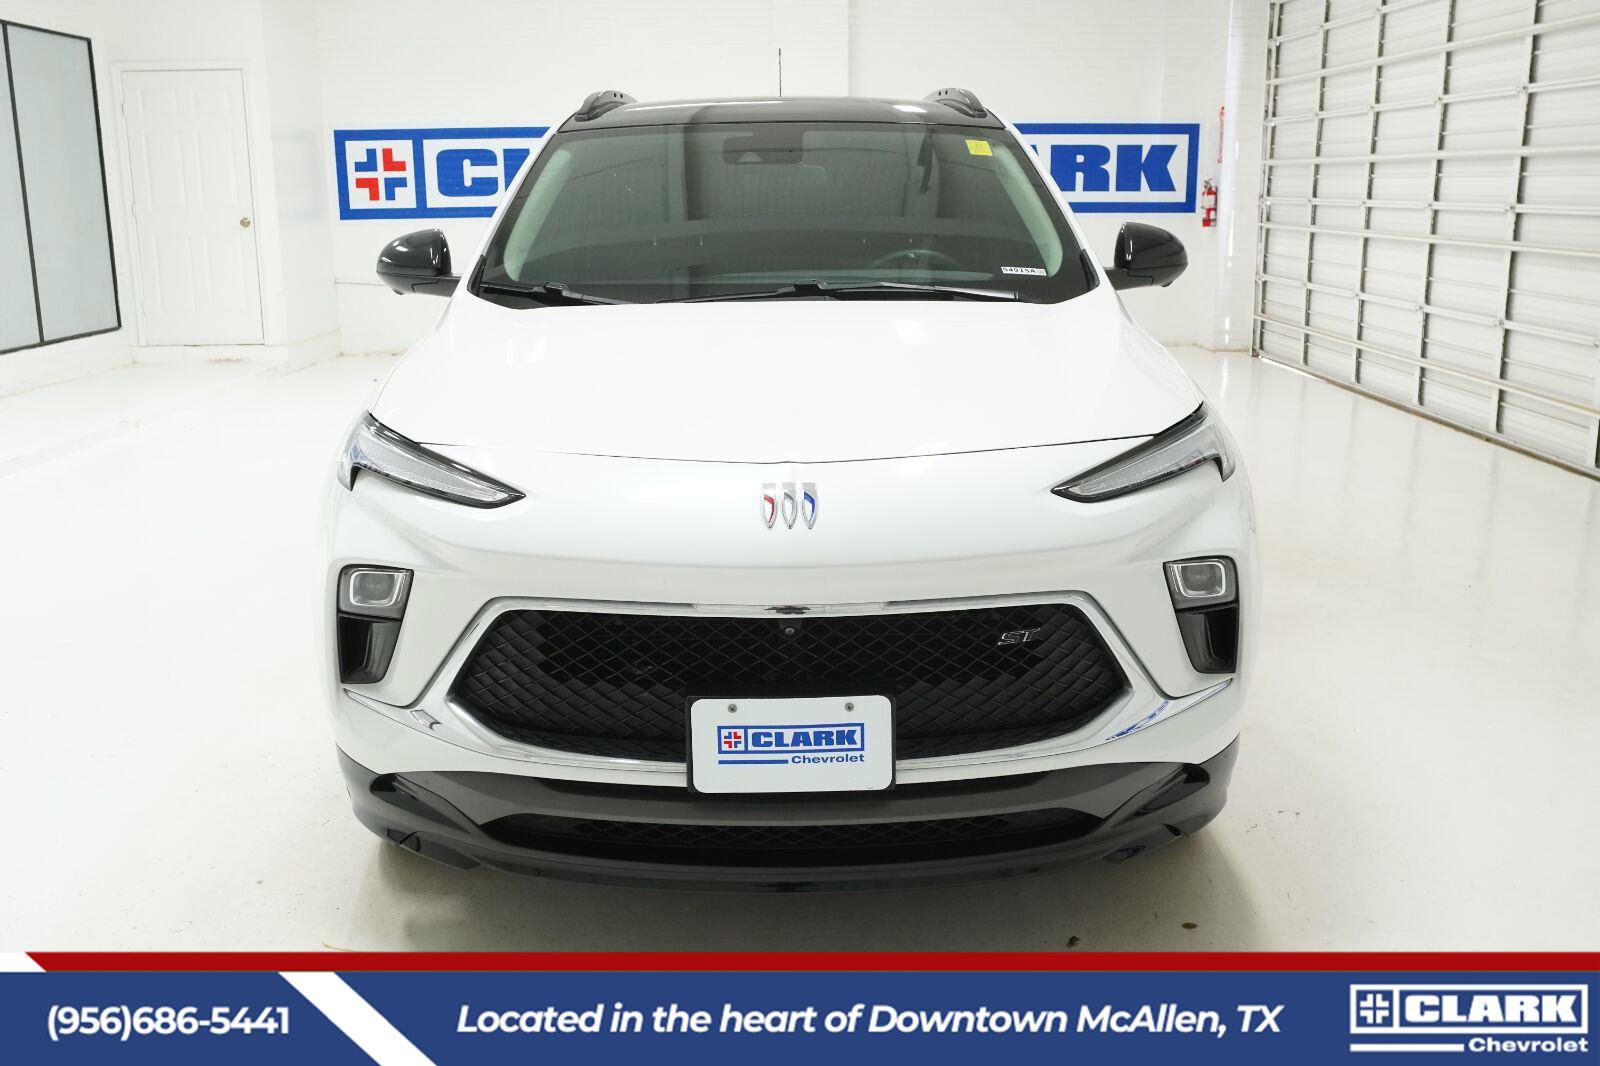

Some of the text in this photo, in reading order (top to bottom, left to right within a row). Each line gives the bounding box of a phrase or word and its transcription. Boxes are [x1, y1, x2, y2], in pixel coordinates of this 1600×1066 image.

[997, 627, 1041, 646] ST
[751, 729, 858, 748] CLARK
[791, 753, 865, 764] Chevrolet
